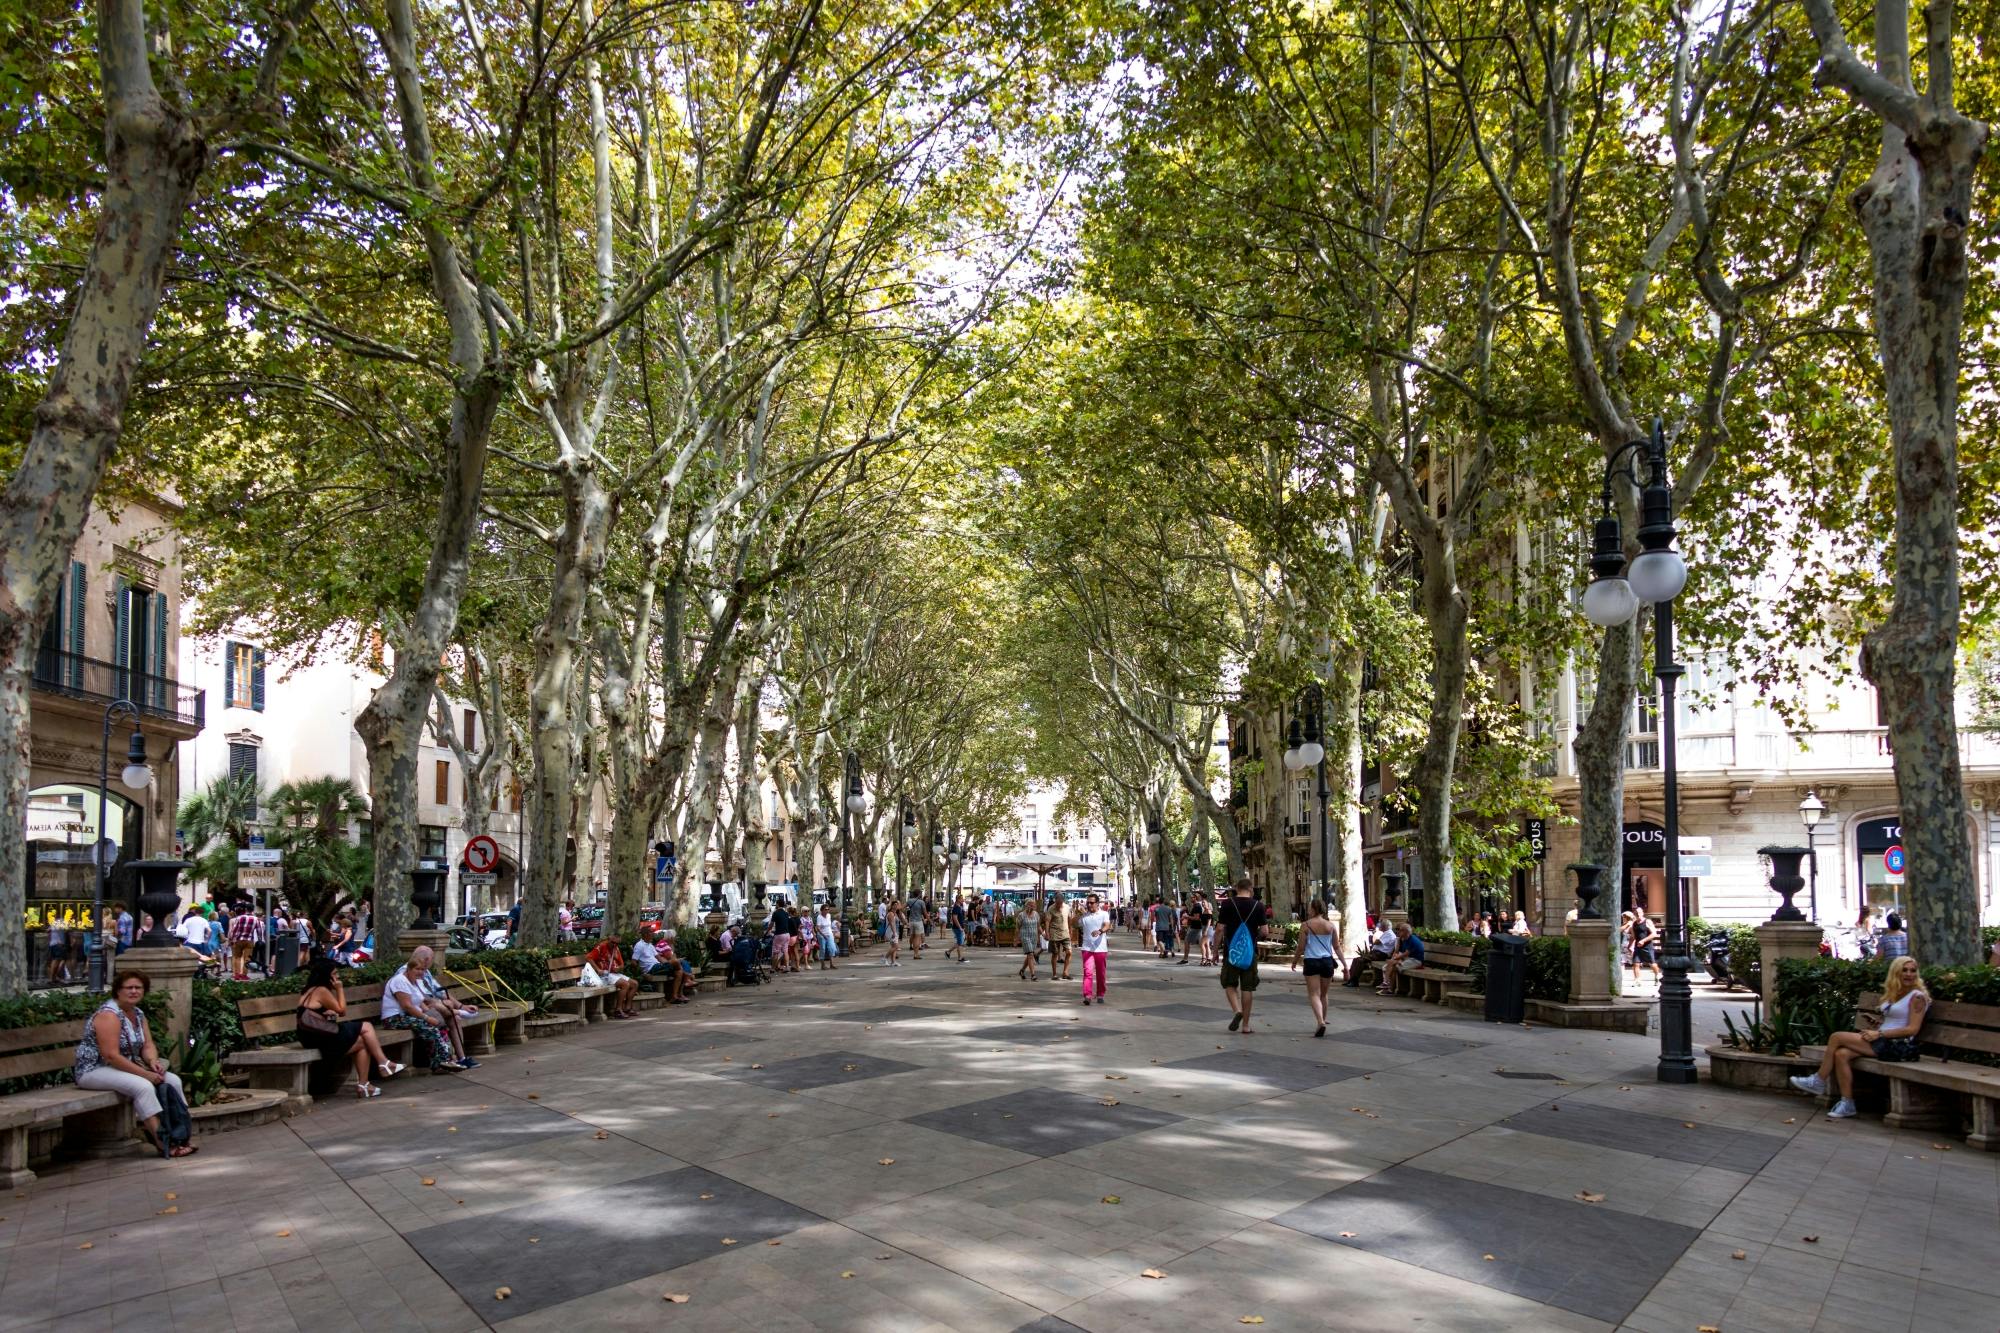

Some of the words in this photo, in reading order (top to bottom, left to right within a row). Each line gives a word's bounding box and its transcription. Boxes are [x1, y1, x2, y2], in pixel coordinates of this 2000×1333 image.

[1531, 821, 1542, 855] TOUS
[243, 870, 275, 878] RIALTO
[243, 878, 274, 886] LIVING
